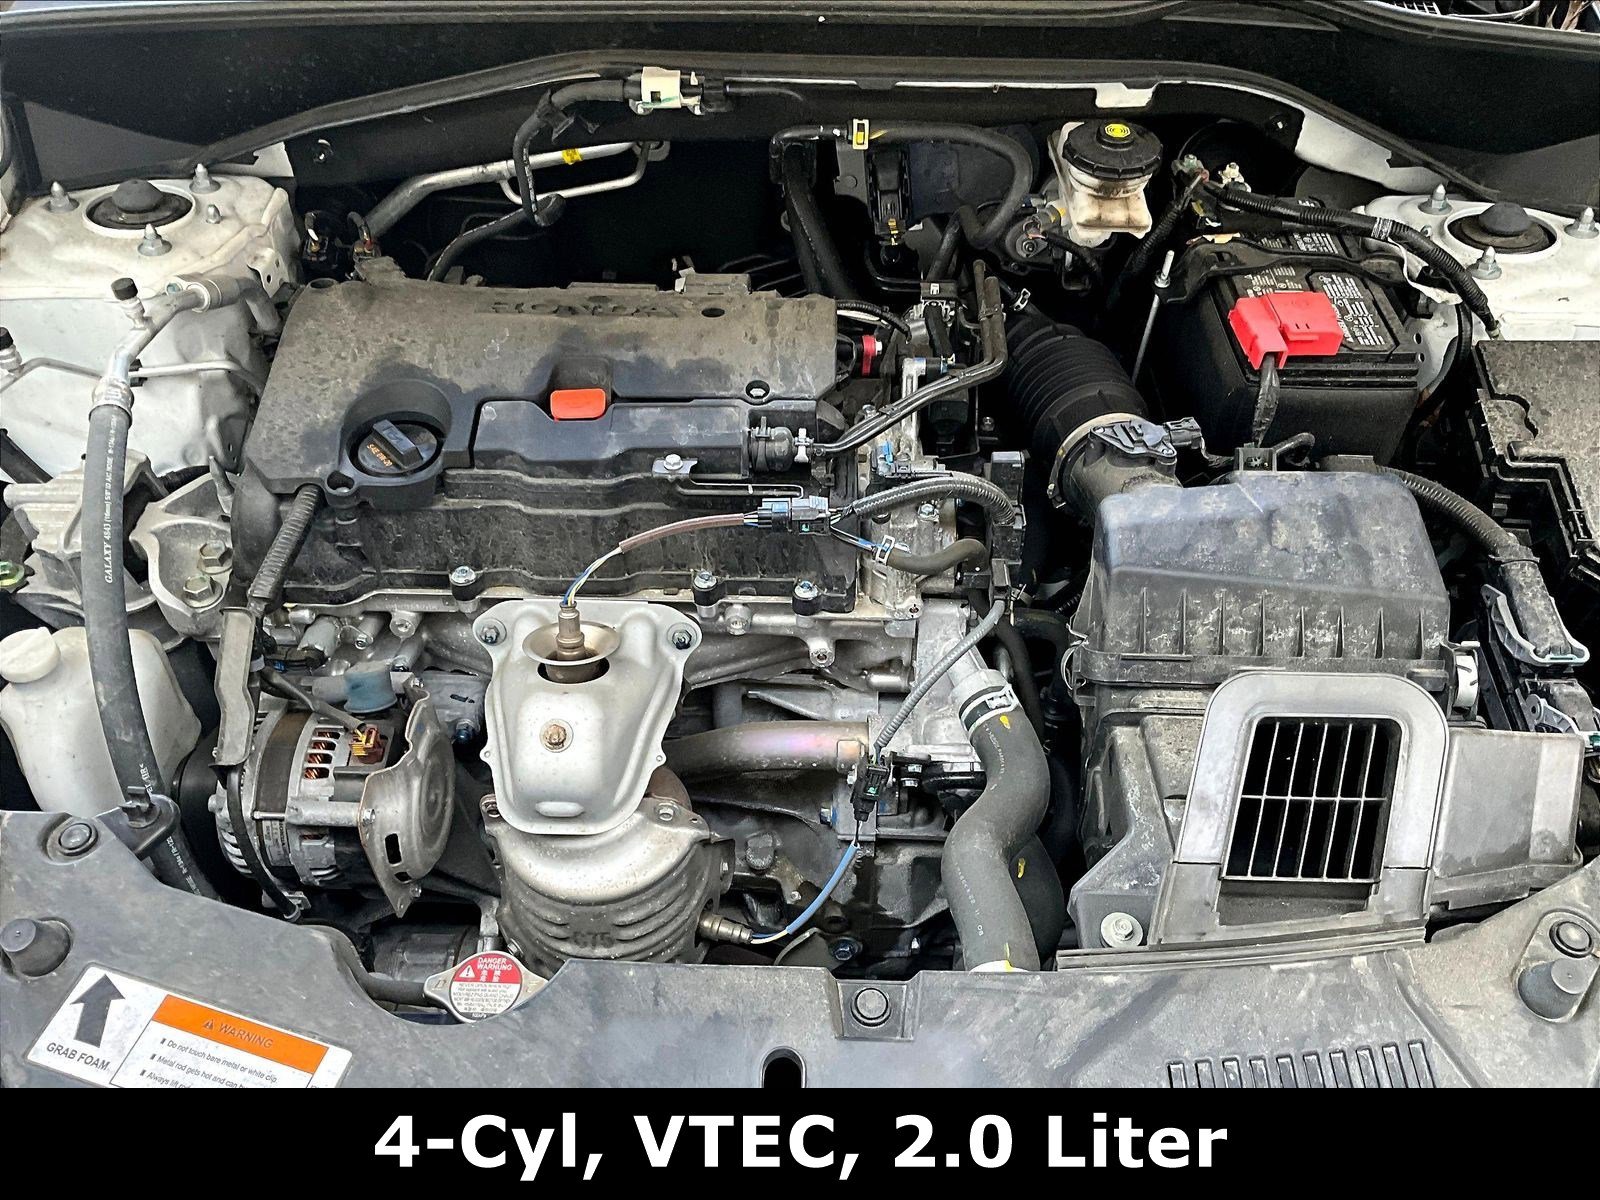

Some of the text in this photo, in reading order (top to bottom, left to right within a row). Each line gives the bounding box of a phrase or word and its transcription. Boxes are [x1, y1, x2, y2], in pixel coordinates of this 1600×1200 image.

[104, 541, 113, 584] GALAXY
[218, 1022, 274, 1049] WARNING
[46, 1042, 111, 1071] GRAB FOAM
[157, 1055, 177, 1068] Metal
[175, 1063, 188, 1072] rod
[185, 1067, 201, 1077] gets
[200, 1071, 213, 1080] hot
[212, 1076, 226, 1085] and
[167, 1040, 178, 1049] Do
[177, 1044, 189, 1053] not
[188, 1047, 206, 1059] touch
[206, 1053, 221, 1064] bare
[221, 1059, 240, 1070] metal
[240, 1065, 248, 1073] or
[247, 1068, 265, 1079] white
[147, 1071, 170, 1086] Always
[170, 1079, 180, 1088] lift
